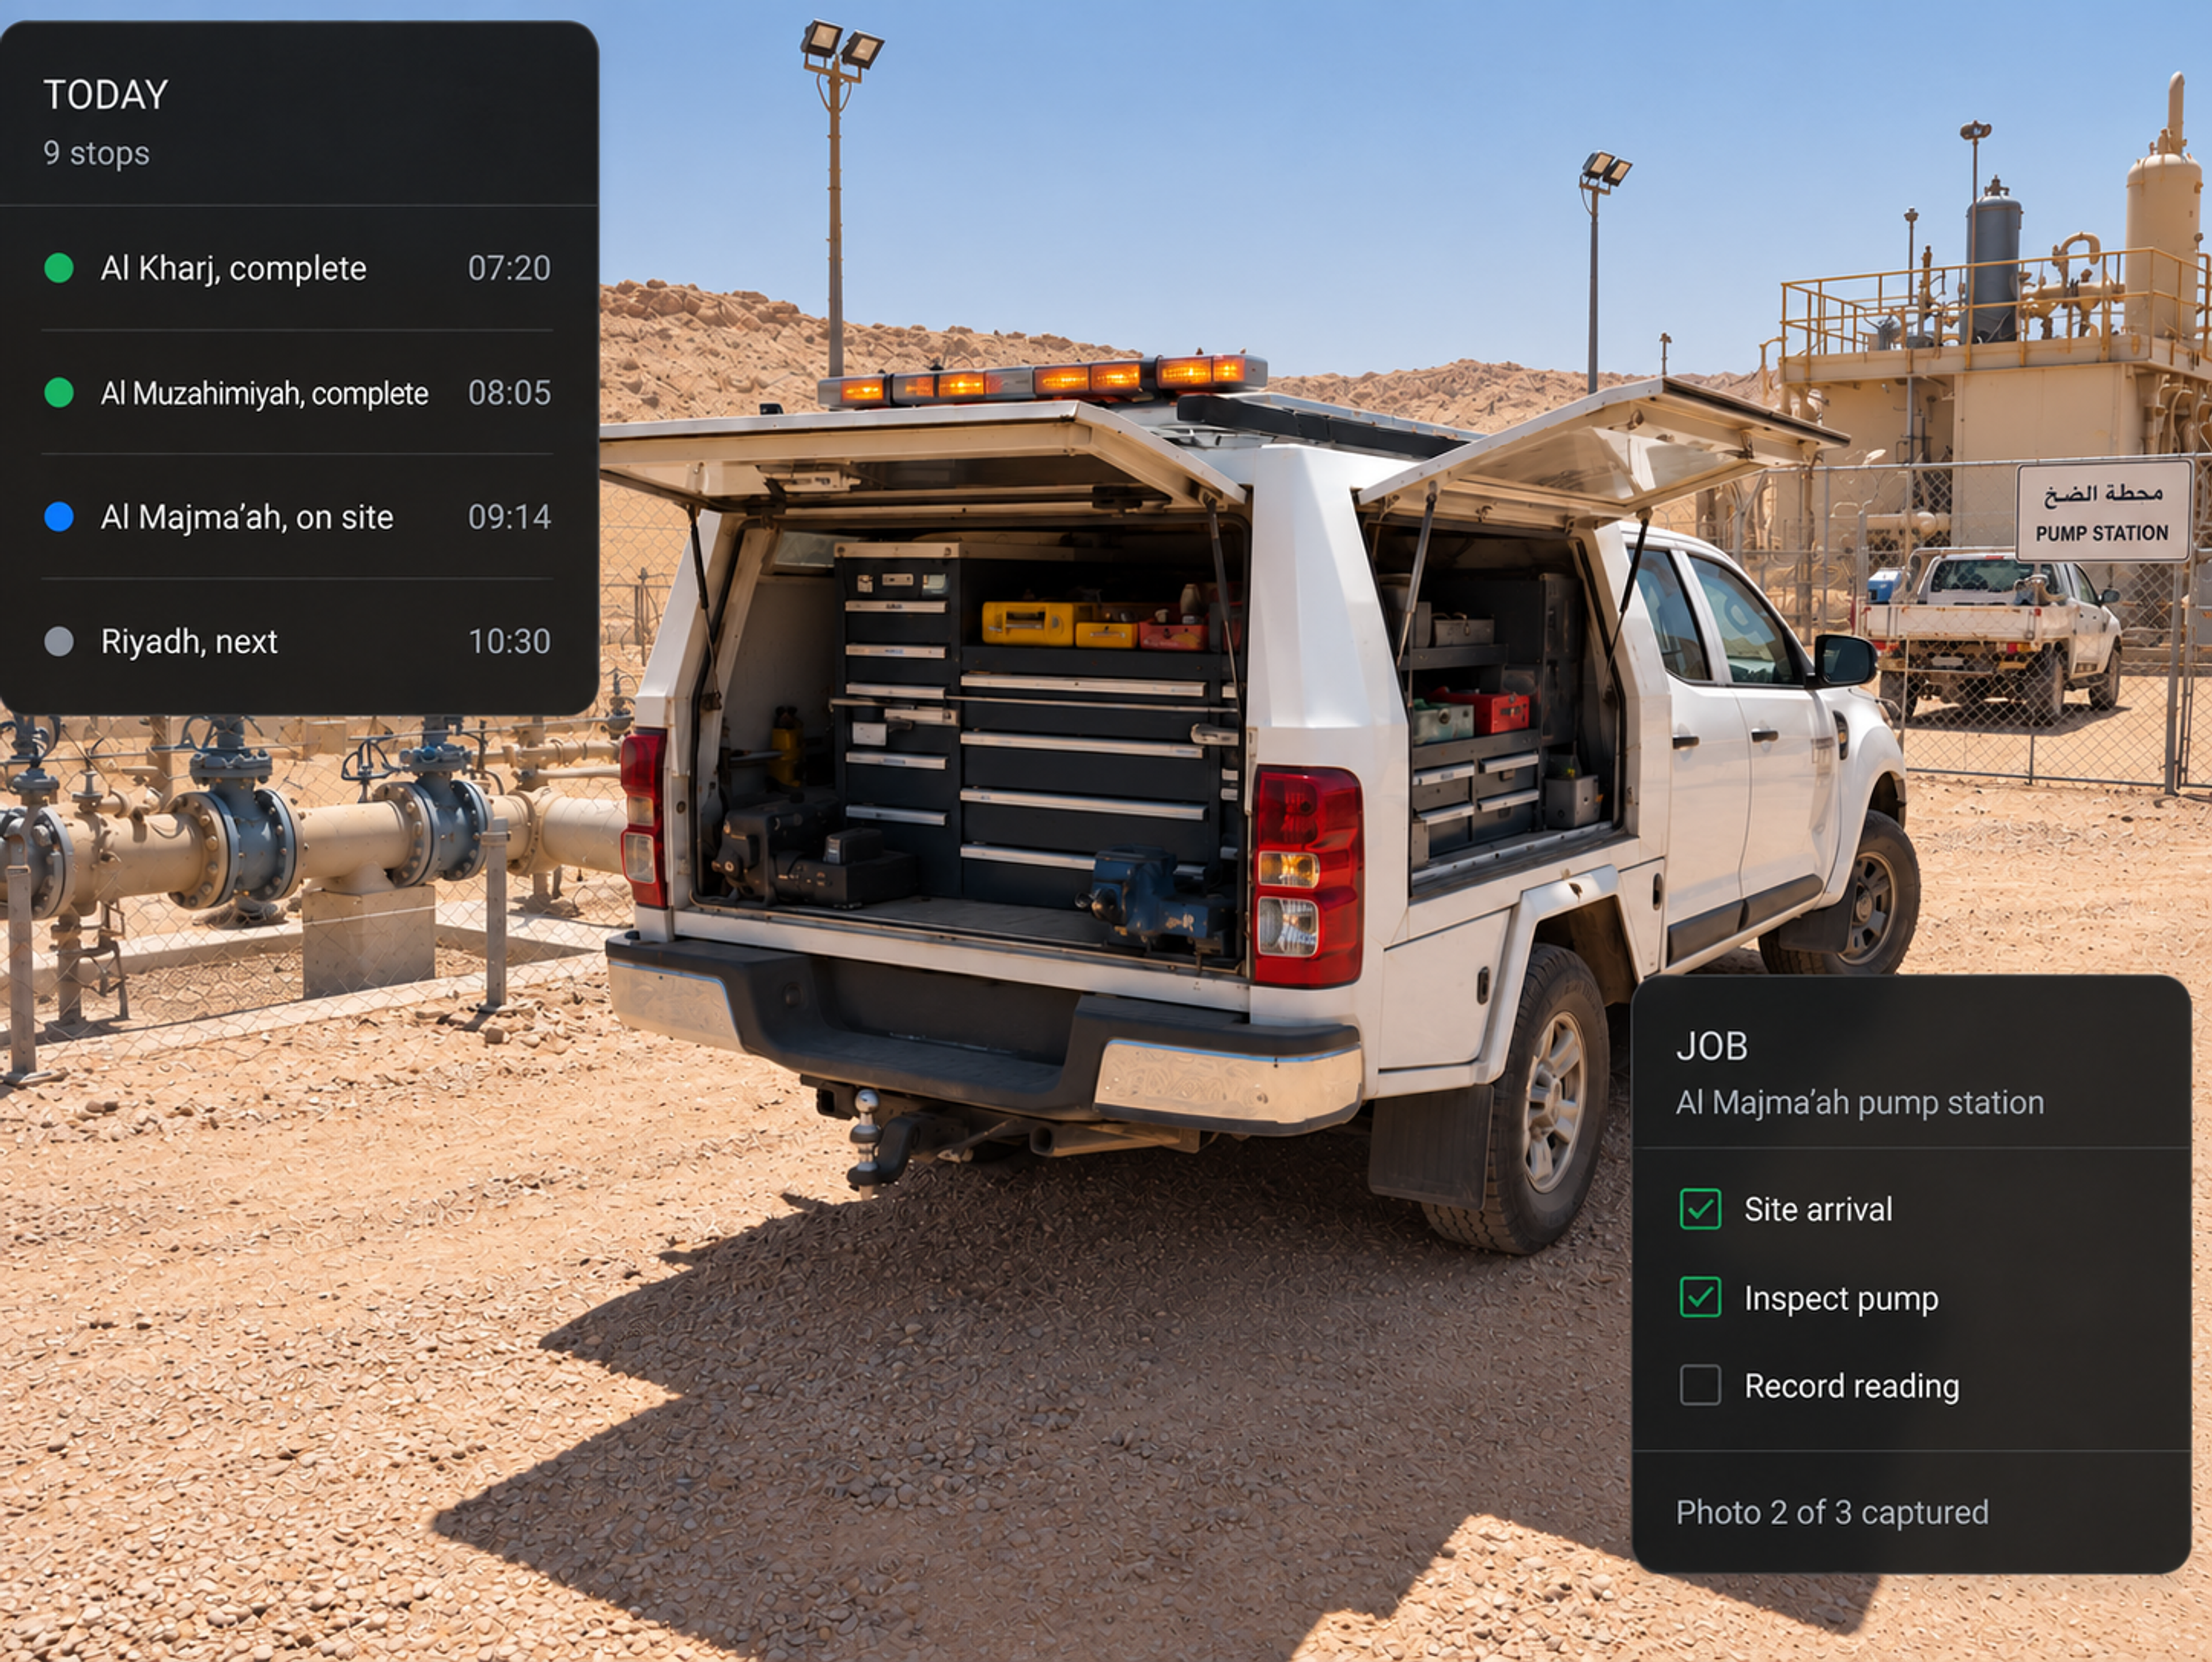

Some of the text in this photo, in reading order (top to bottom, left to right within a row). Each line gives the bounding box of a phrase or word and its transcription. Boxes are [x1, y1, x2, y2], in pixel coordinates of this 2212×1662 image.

[2044, 483, 2164, 510] محطة الضخ
[2036, 524, 2169, 542] PUMP STATION
